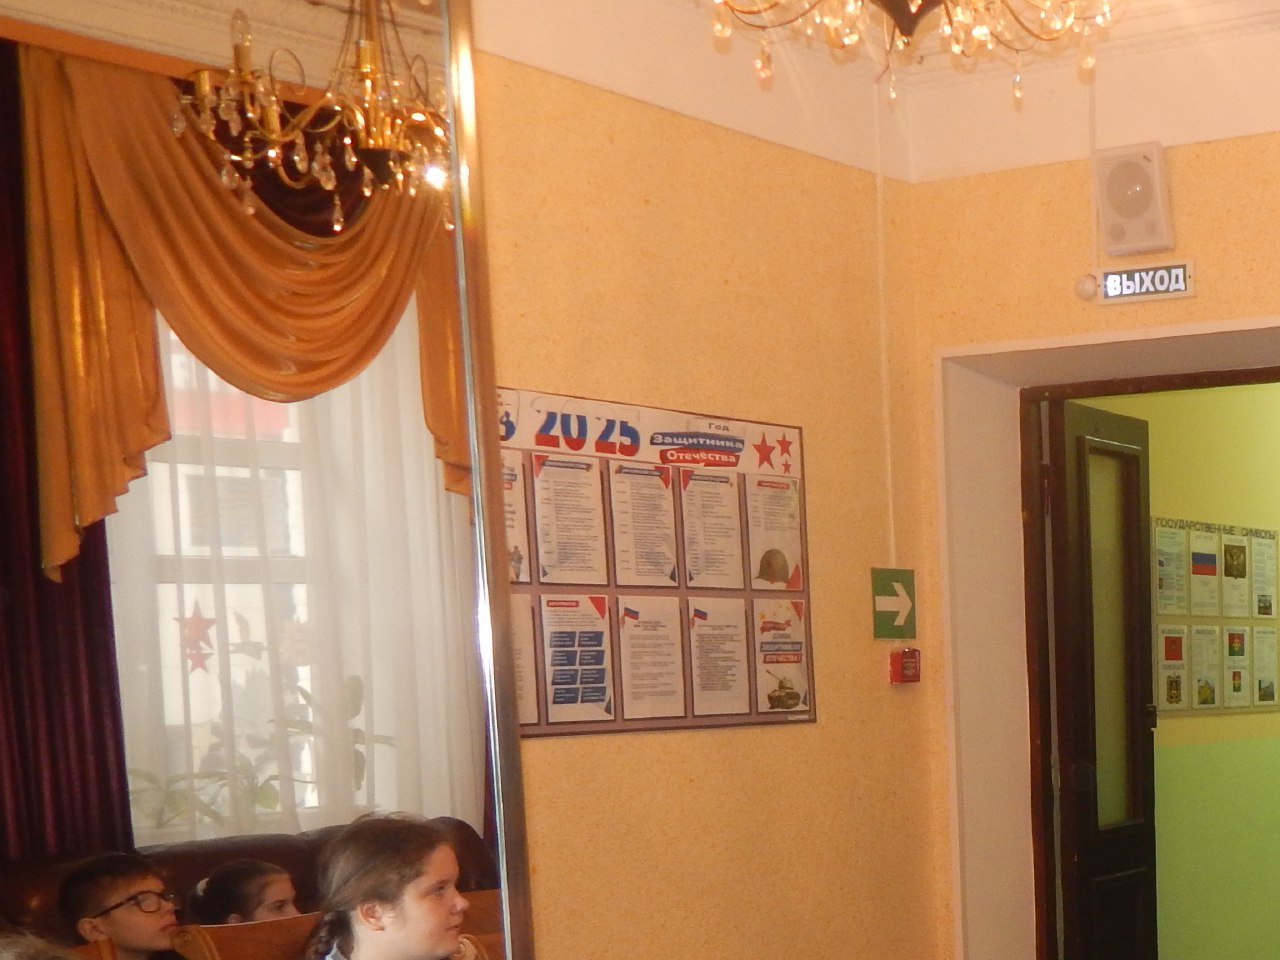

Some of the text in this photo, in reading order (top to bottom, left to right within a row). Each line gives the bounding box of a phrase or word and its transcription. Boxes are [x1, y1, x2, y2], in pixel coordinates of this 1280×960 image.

[1106, 268, 1186, 297] ВЫХОД
[532, 400, 640, 457] 2025
[708, 421, 731, 433] Год
[653, 433, 744, 451] Защитника
[666, 450, 737, 466] Отечества
[1156, 518, 1276, 540] ГОСУДАРСТВЕННЫЕ СИМВОЛЫ
